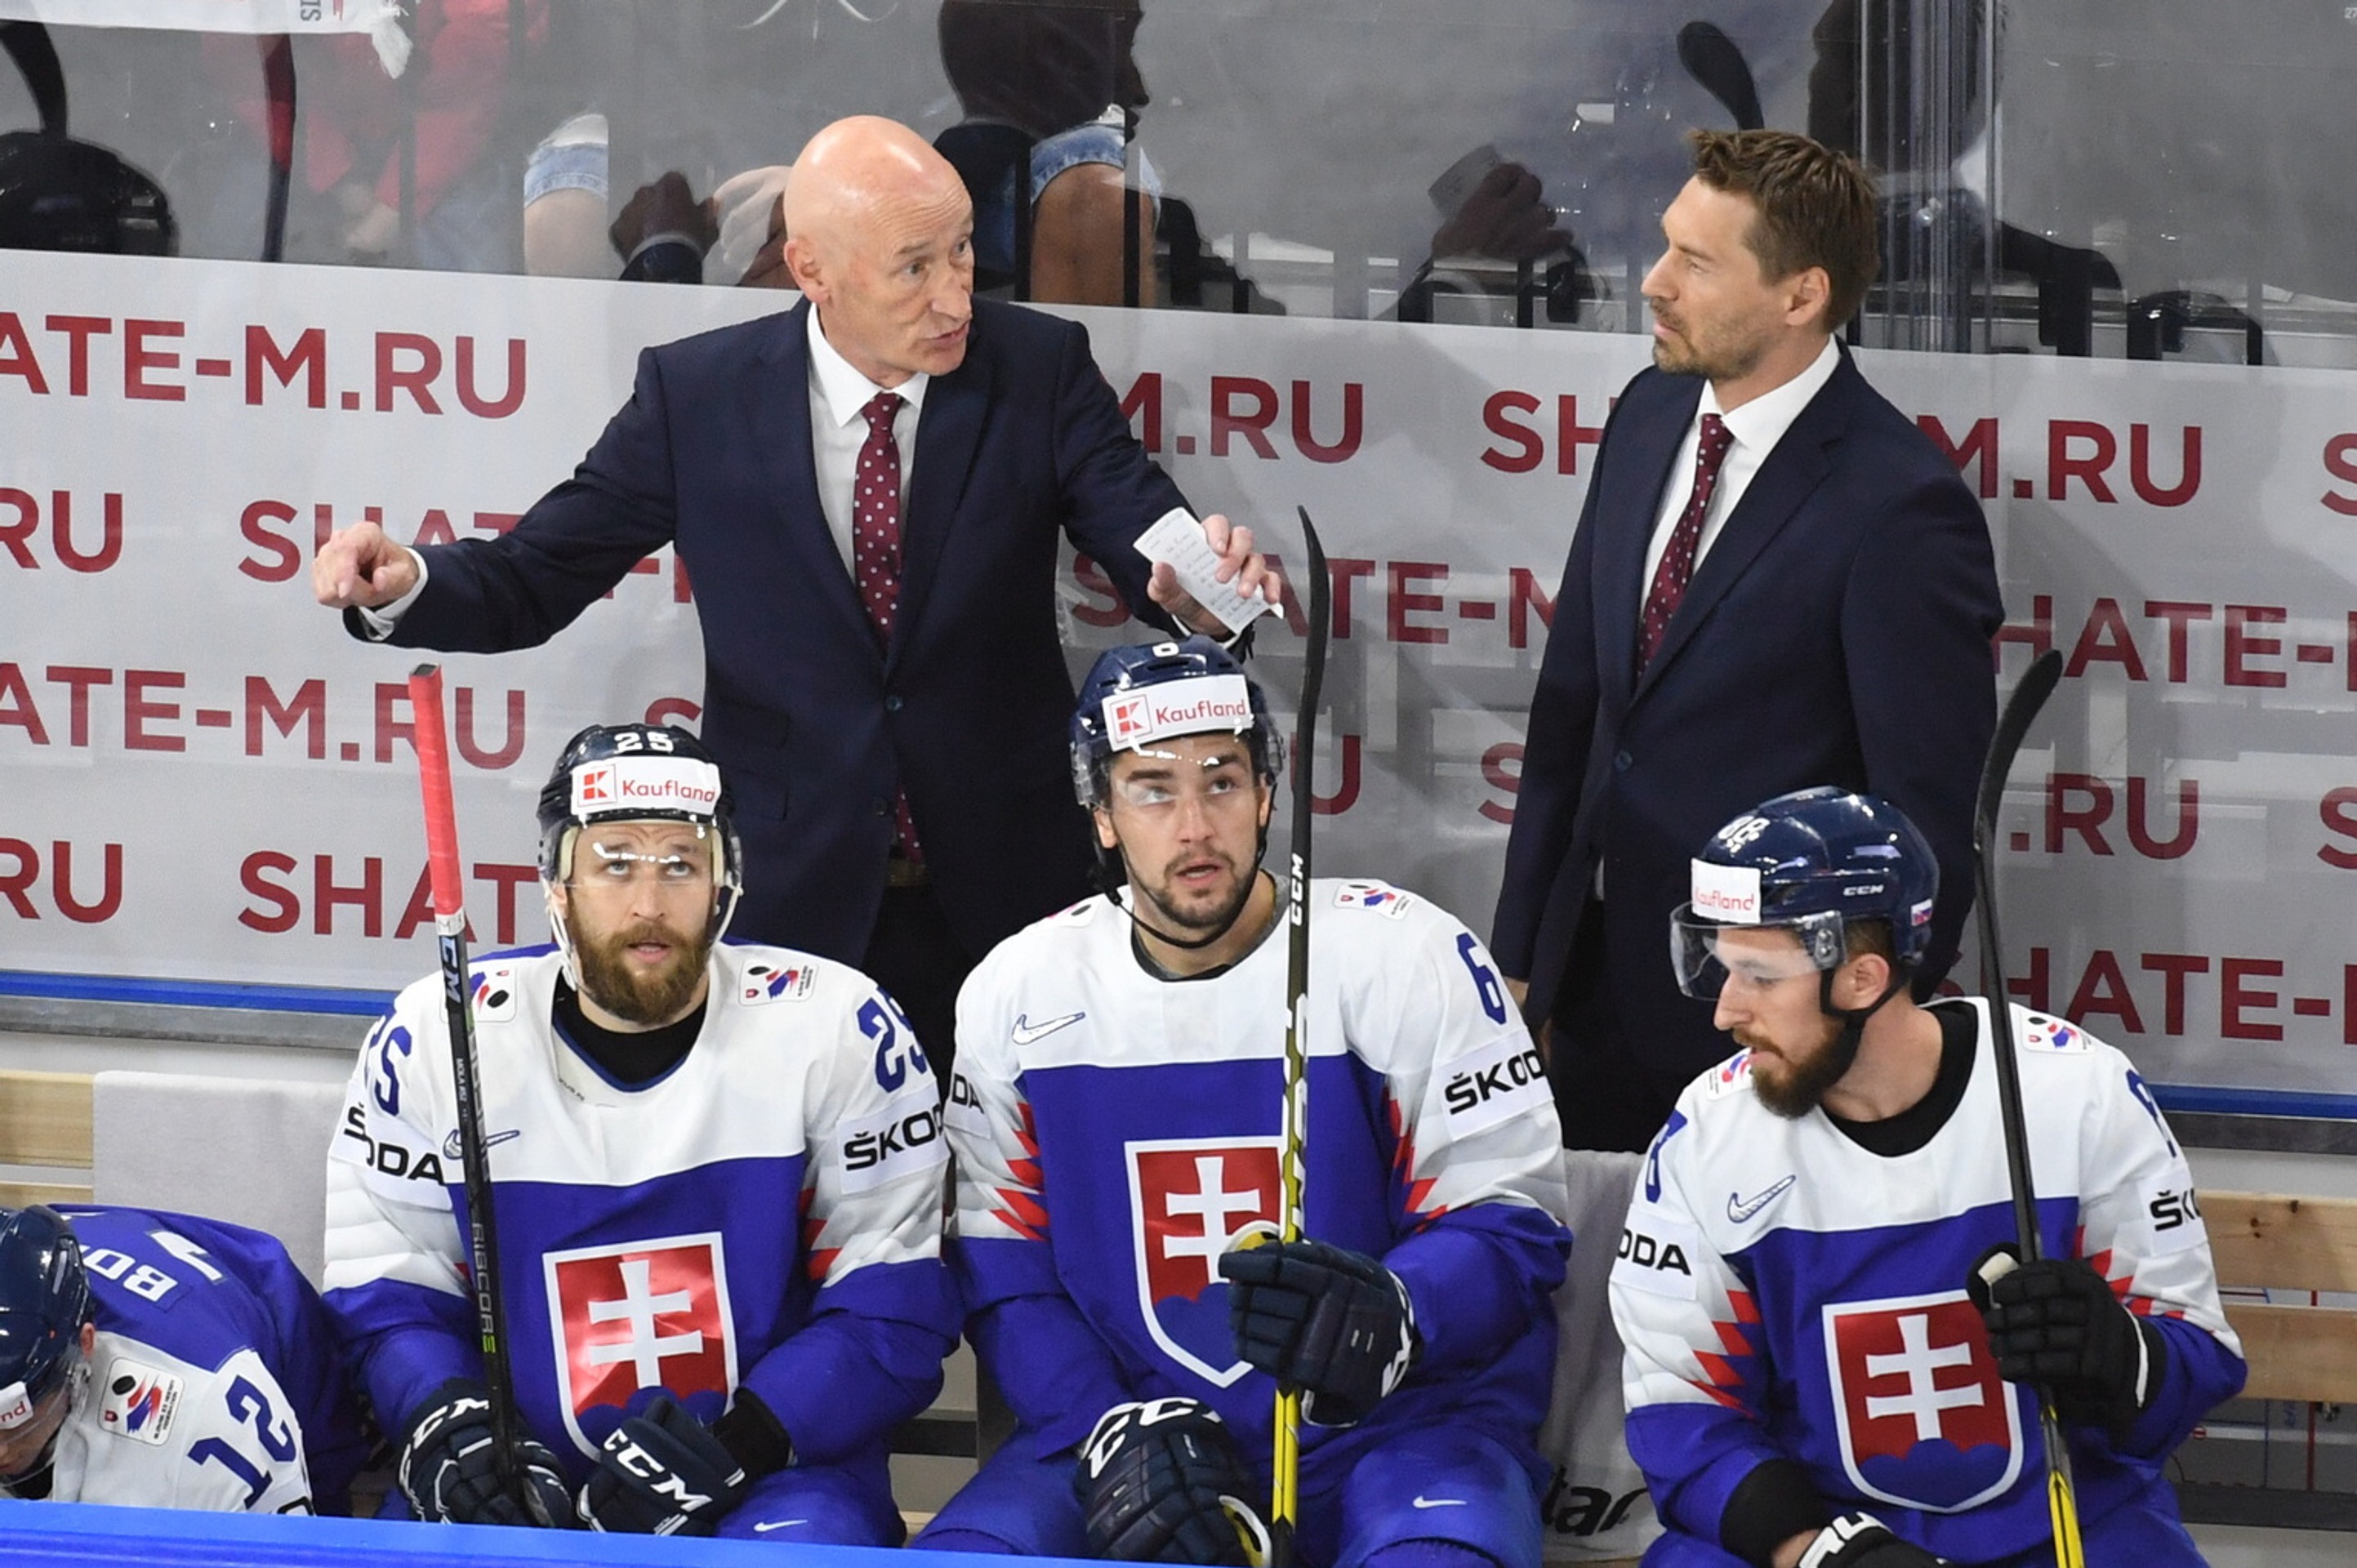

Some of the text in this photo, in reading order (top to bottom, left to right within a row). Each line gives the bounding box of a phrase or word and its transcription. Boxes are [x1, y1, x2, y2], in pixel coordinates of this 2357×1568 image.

[1156, 699, 1247, 725] Kaufland
[614, 732, 675, 755] 25
[622, 779, 716, 804] Kaufland
[1291, 853, 1304, 927] CCM
[1456, 932, 1508, 1025] 6
[79, 1244, 179, 1302] BO
[187, 1374, 297, 1511] 12
